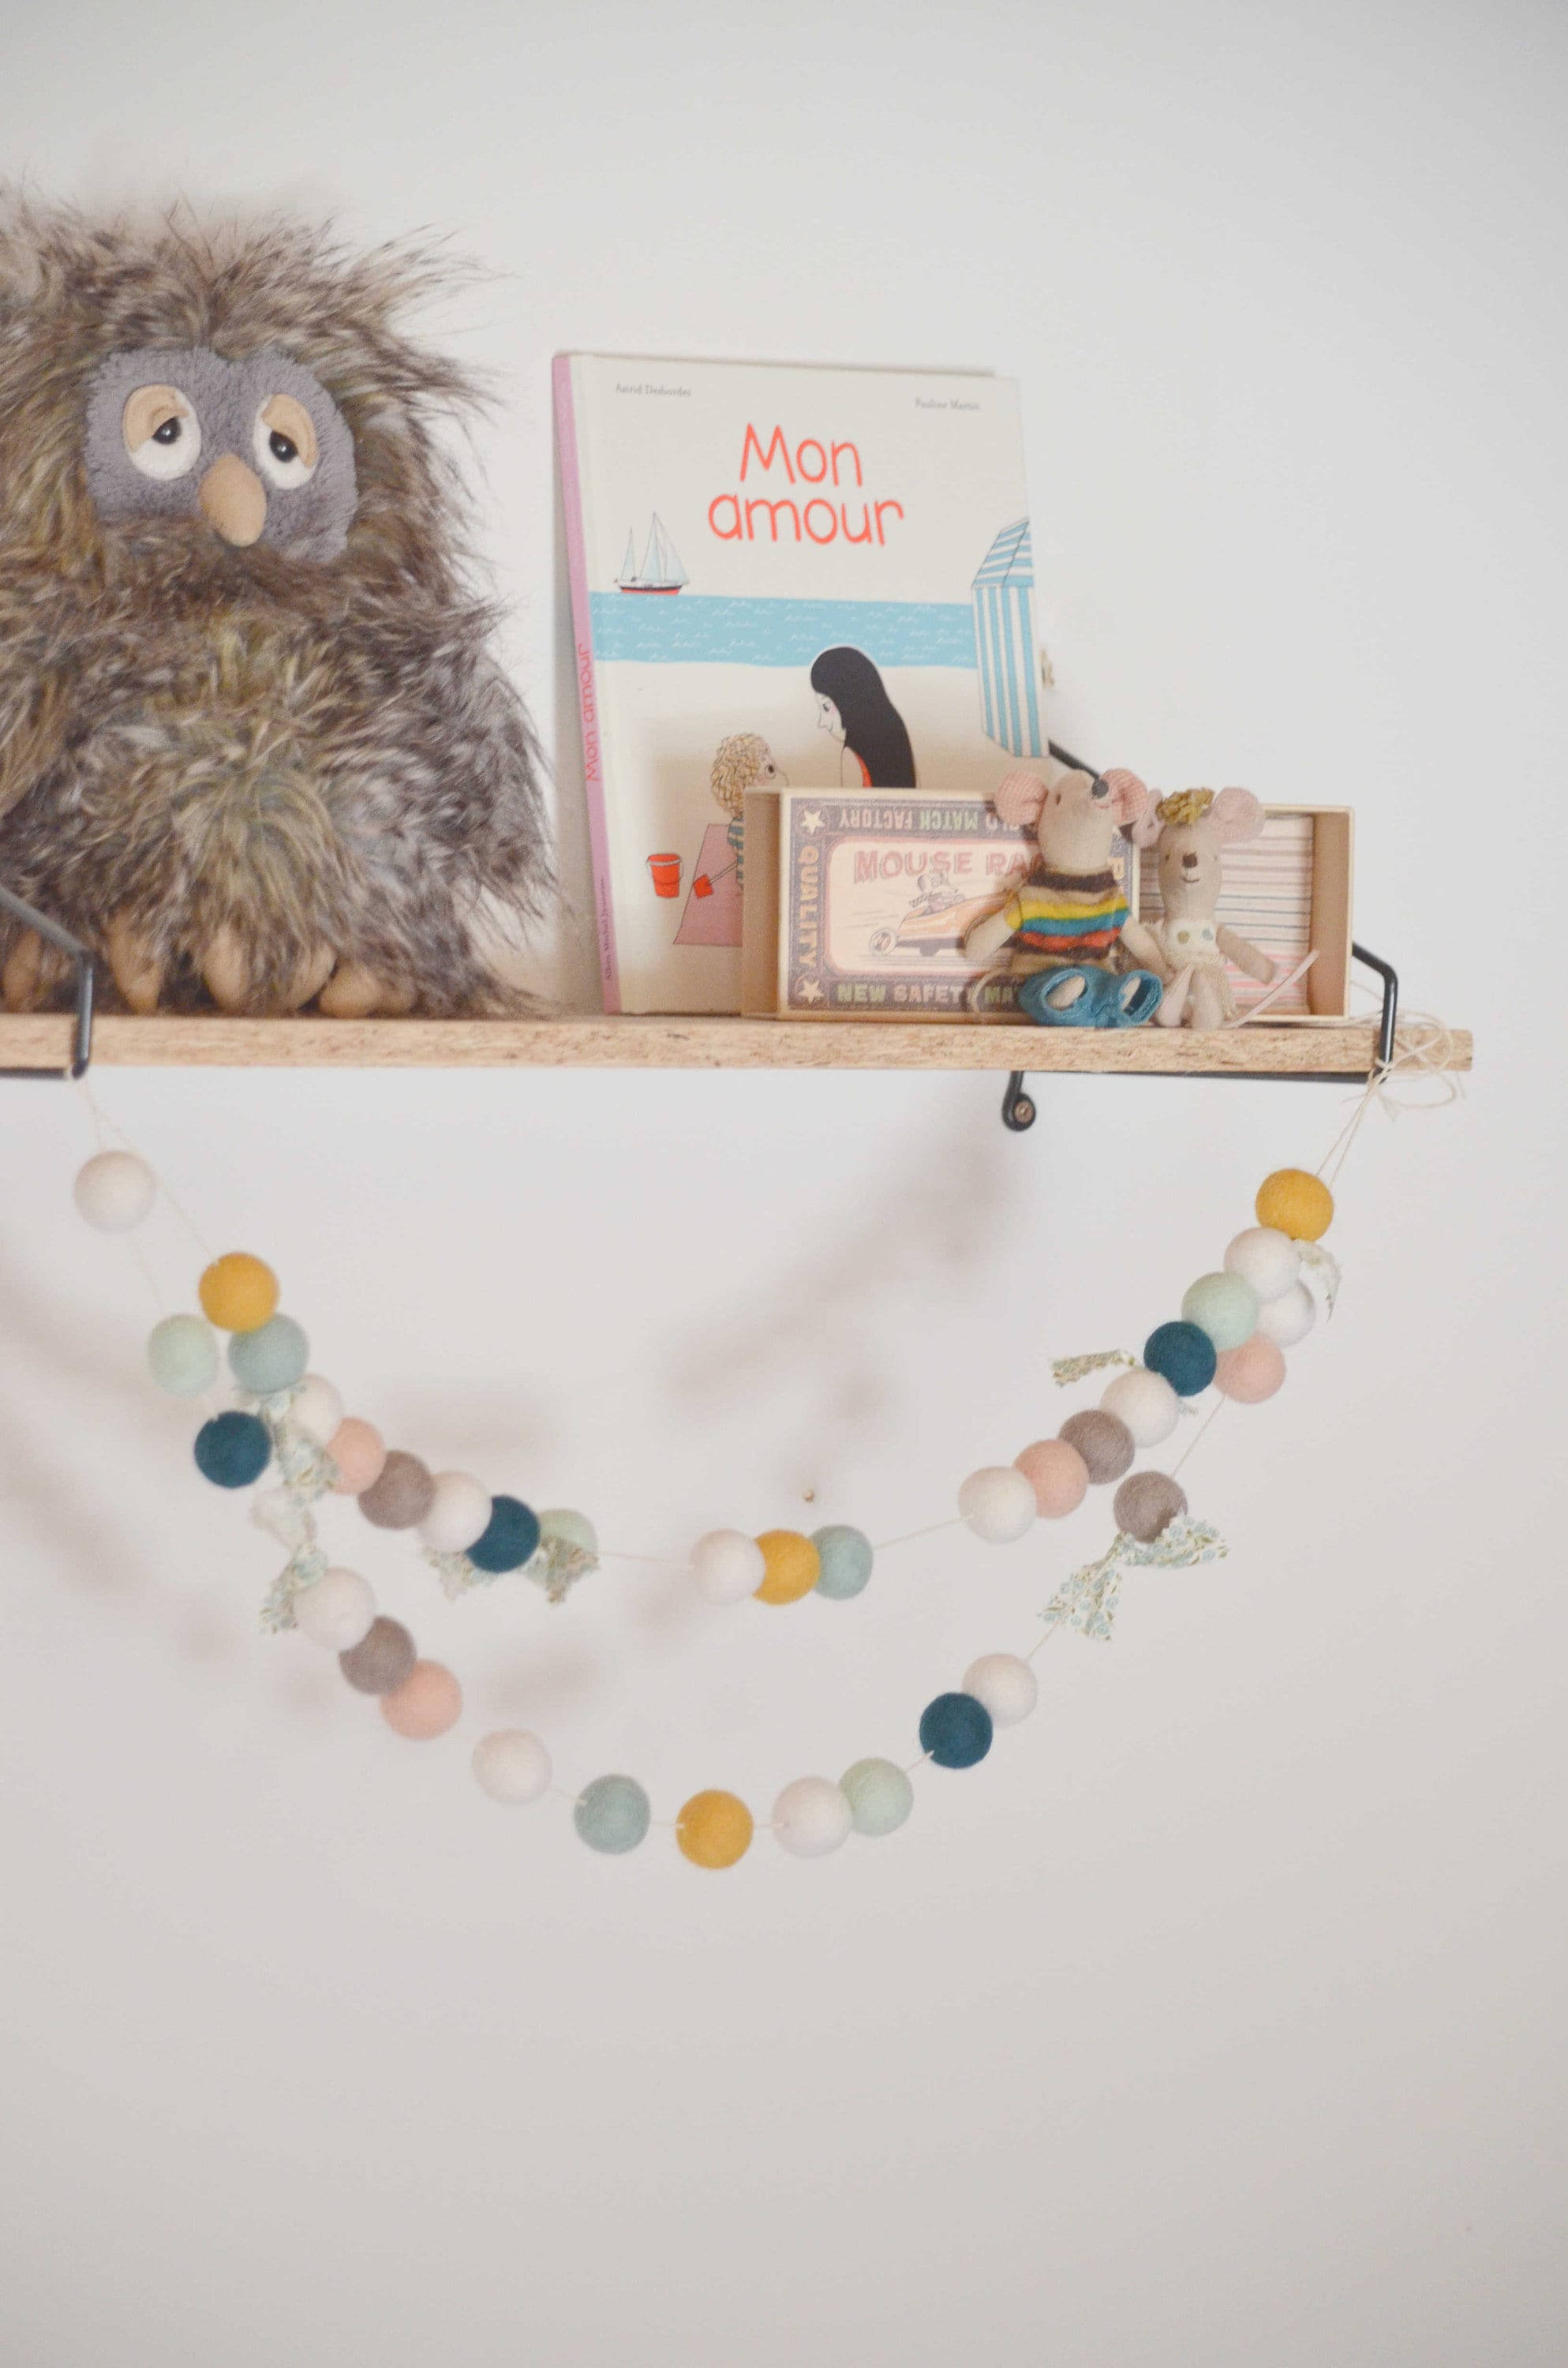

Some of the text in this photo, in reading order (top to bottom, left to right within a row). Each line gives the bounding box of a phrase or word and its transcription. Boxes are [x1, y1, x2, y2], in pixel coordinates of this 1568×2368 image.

[739, 422, 863, 487] Mon
[708, 493, 904, 546] amour
[578, 643, 601, 782] Mon amour
[838, 807, 912, 829] FACTORY
[919, 808, 979, 830] MATCH
[853, 850, 973, 884] MOUSE
[797, 845, 819, 969] QUALITY
[836, 984, 887, 1003] NEW
